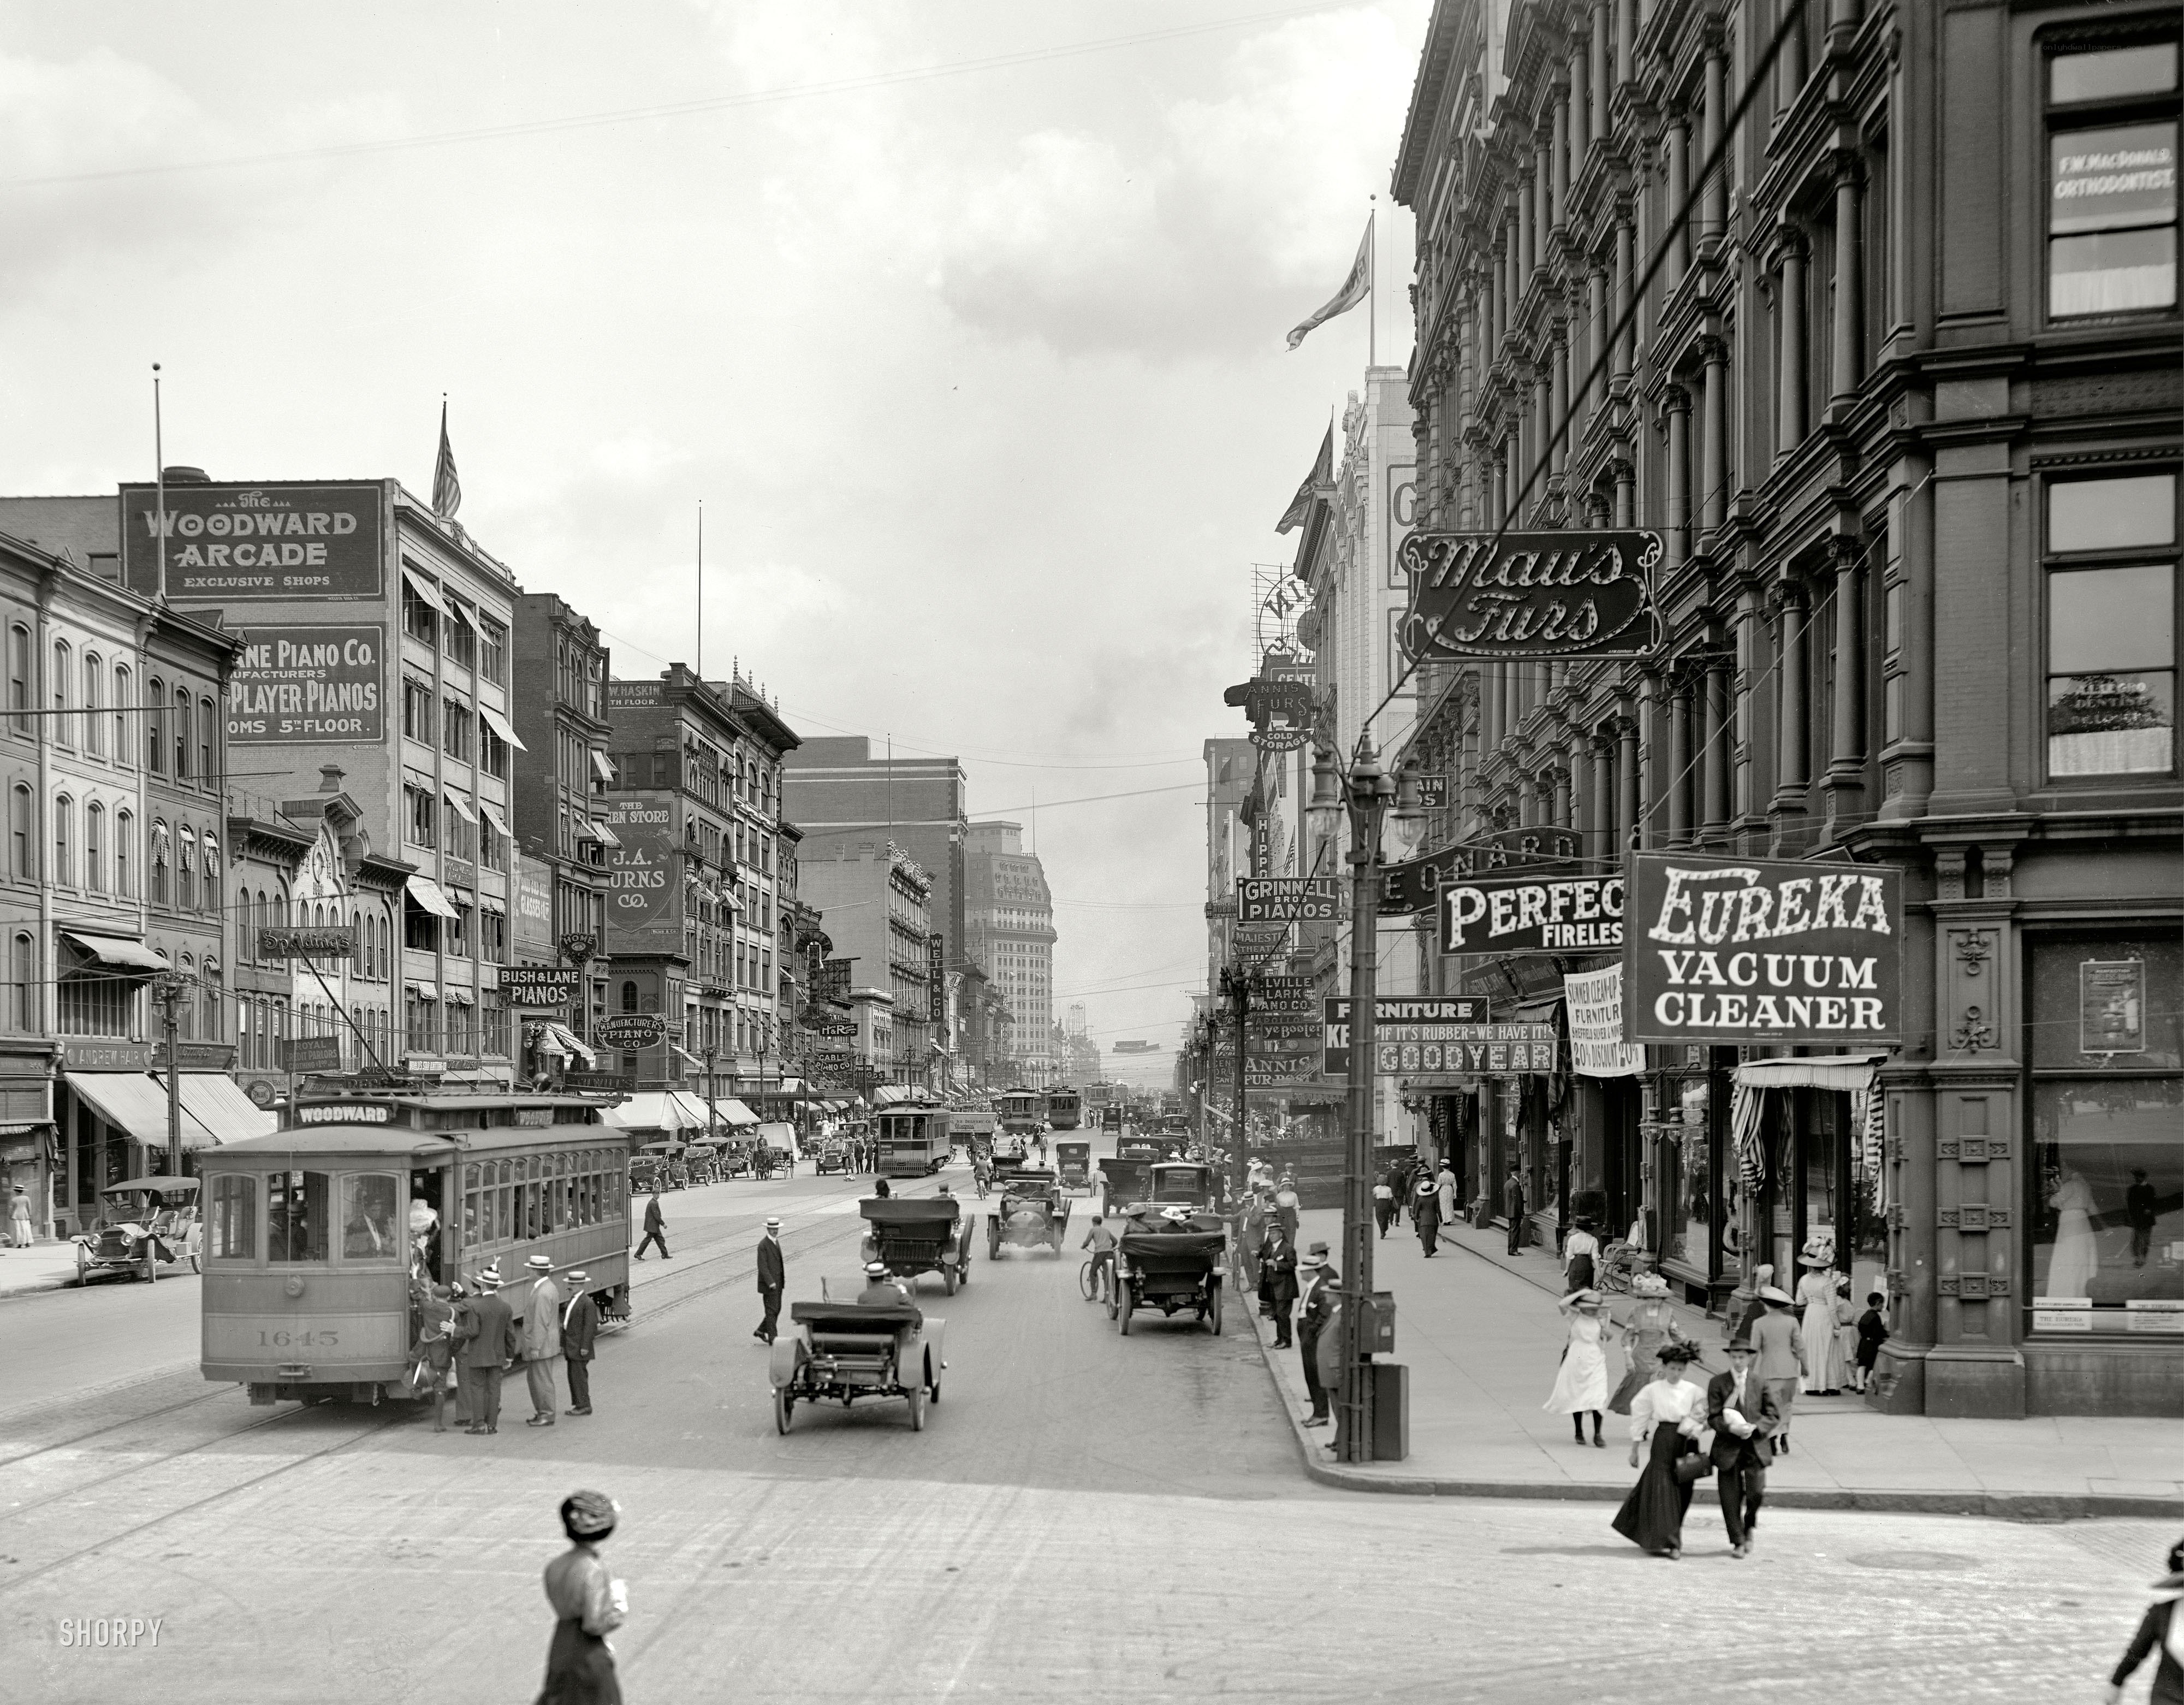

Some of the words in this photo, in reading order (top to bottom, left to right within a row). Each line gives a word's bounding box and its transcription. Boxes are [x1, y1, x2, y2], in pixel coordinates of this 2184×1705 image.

[239, 491, 270, 507] The
[144, 510, 357, 537] WOODWARD
[173, 543, 327, 567] ARCADE
[1428, 537, 1623, 588] Mau's
[184, 576, 274, 587] EXCLUSIVE
[283, 575, 330, 586] SHOPS
[1454, 591, 1599, 643] Furs
[278, 640, 339, 667] PIANO
[343, 638, 376, 666] CO.
[1245, 683, 1298, 701] ANNIS
[1257, 697, 1308, 719] FURS
[1252, 734, 1308, 749] STORAGE
[1266, 732, 1293, 741] COLD
[630, 810, 669, 824] STORE
[444, 860, 472, 876] WOODWARD
[447, 872, 470, 885] ARCADE
[1245, 880, 1337, 900] GRINNELL
[618, 893, 648, 908] CO.
[1648, 866, 1892, 945] EUREKA
[1250, 903, 1332, 919] PIANOS
[563, 934, 595, 945] HOME
[931, 939, 942, 979] WEIL
[1657, 949, 1878, 989] VACUUM
[501, 971, 536, 984] BUSH
[536, 972, 546, 983] &
[547, 971, 579, 984] LANE
[512, 986, 568, 1004] PIANOS
[933, 984, 941, 993] &
[1261, 989, 1302, 999] LARK
[1568, 982, 1590, 1005] SUMMER
[933, 998, 941, 1017] CO
[1291, 1000, 1310, 1010] CO.
[1337, 1003, 1473, 1017] FRNITURE
[1654, 991, 1886, 1030] CLEANER
[600, 1018, 662, 1031] MANUFACTURERS
[609, 1029, 652, 1039] PIANO
[1381, 1027, 1392, 1040] IF
[1396, 1026, 1419, 1040] IT'S
[1498, 1026, 1527, 1040] HAVE
[1532, 1026, 1548, 1039] IT!
[296, 1040, 327, 1051] ROYAL
[624, 1040, 640, 1048] CO
[79, 1049, 117, 1065] ANDREW
[286, 1052, 307, 1062] CREDIT
[308, 1049, 337, 1060] PARLORS
[1380, 1044, 1551, 1070] GOODYEAR
[1591, 1042, 1618, 1068] DISCOUNT
[1245, 1056, 1310, 1072] ANNIS
[1245, 1074, 1273, 1085] FUR
[300, 1107, 388, 1122] WOODWARD
[258, 1330, 339, 1347] 1645
